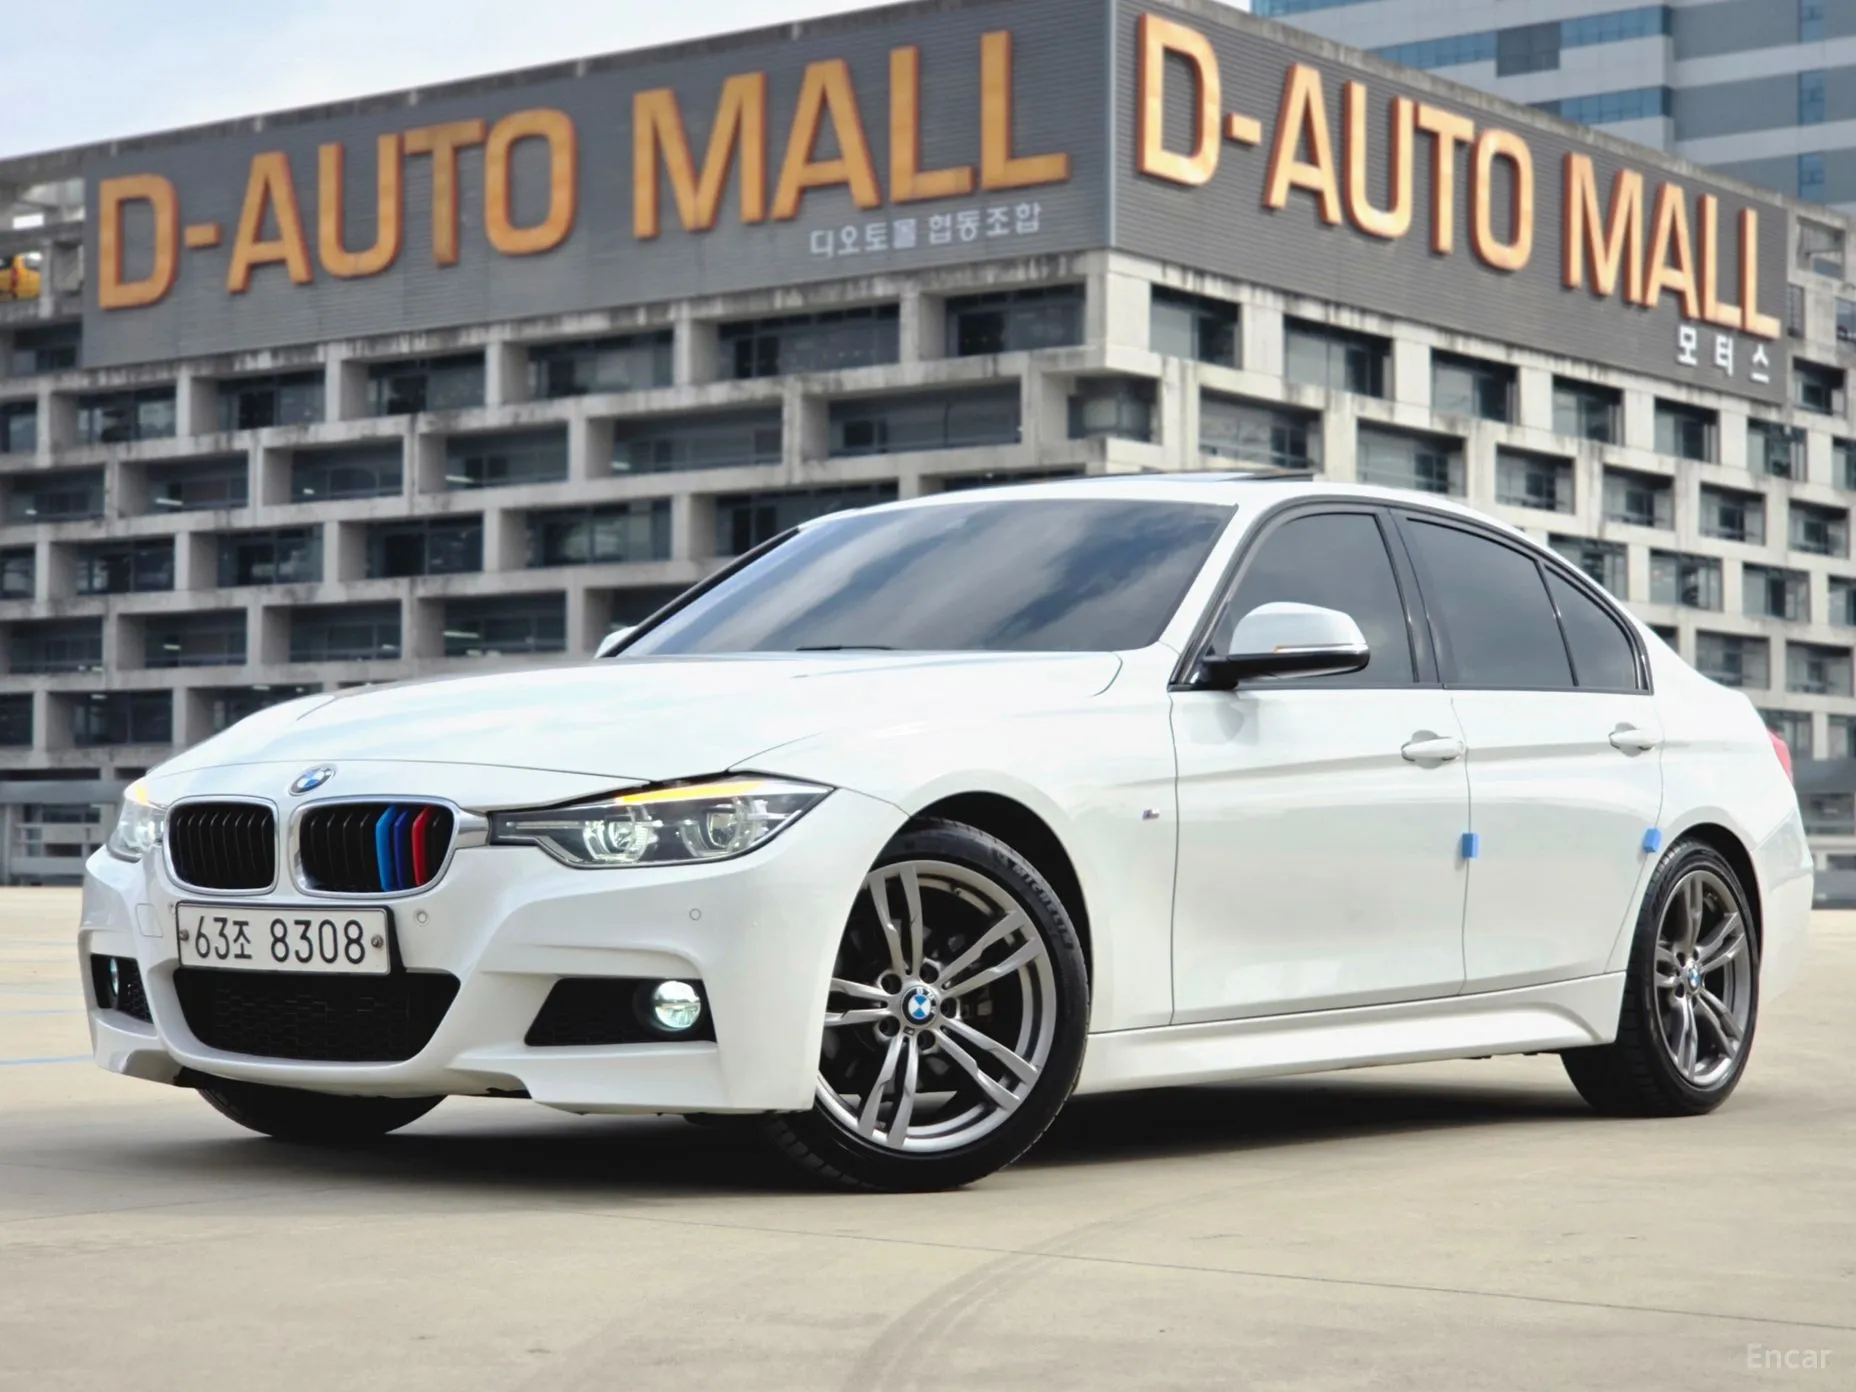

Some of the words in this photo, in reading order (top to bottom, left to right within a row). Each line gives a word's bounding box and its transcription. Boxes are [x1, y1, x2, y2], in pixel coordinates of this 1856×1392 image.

[99, 108, 578, 311] D-AUTO
[632, 30, 1070, 240] MALL
[1137, 11, 1535, 272] D-AUTO
[1563, 152, 1781, 340] MALL
[928, 202, 1042, 245] 협동조합
[1678, 324, 1770, 384] 모터스
[195, 915, 253, 961] 63조
[270, 917, 367, 966] 8308
